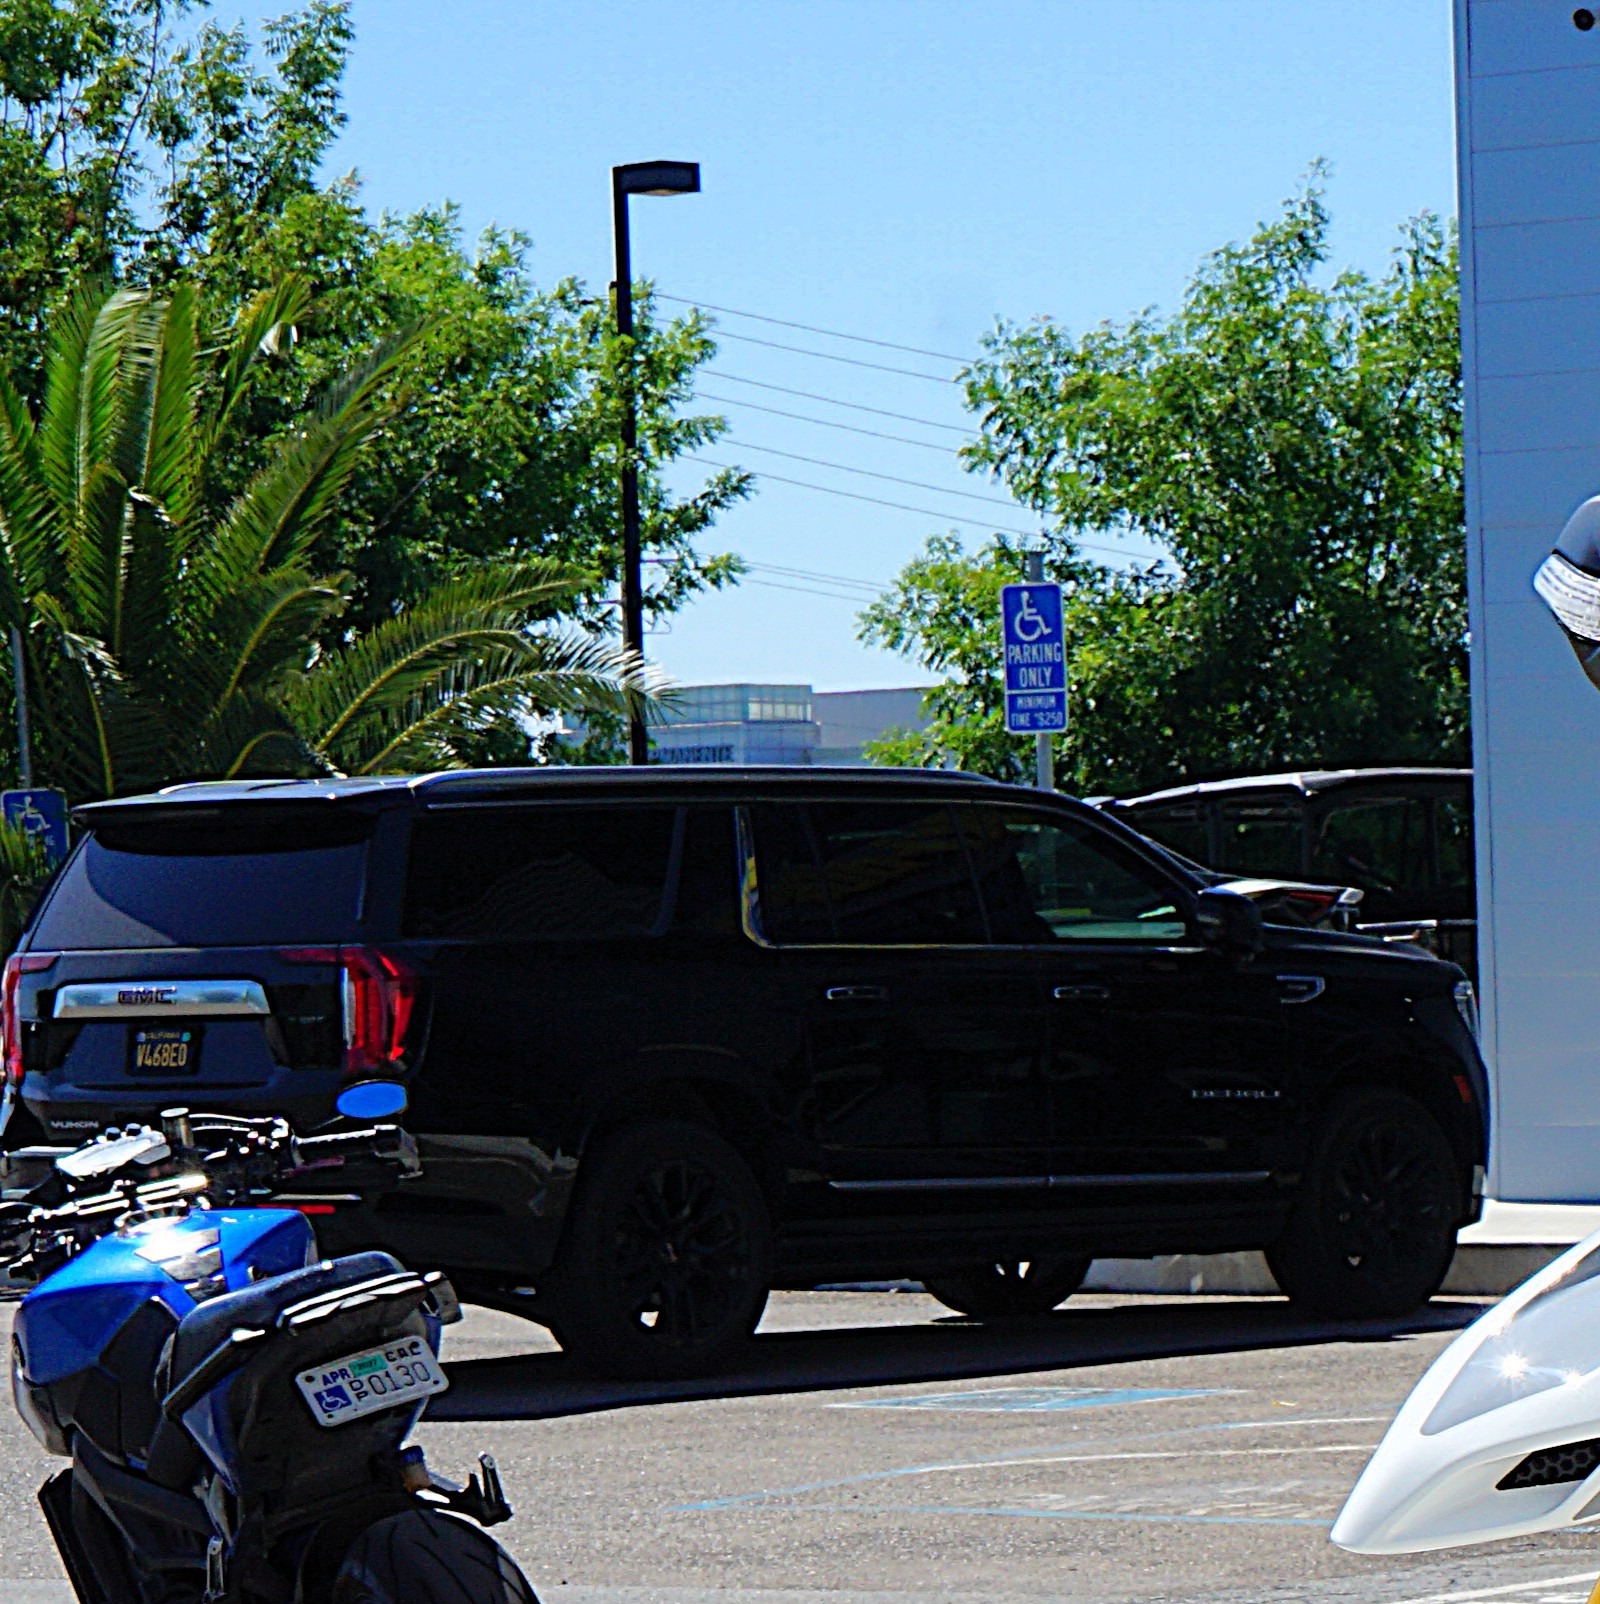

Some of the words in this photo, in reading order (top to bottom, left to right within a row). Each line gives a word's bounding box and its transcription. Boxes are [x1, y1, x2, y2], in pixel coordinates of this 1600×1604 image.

[1007, 642, 1062, 664] PARKING
[1020, 667, 1053, 688] ONLY
[1017, 695, 1057, 709] MINIMUM
[118, 986, 178, 1005] GMC
[322, 1368, 351, 1387] APR
[367, 1361, 431, 1395] 0130
